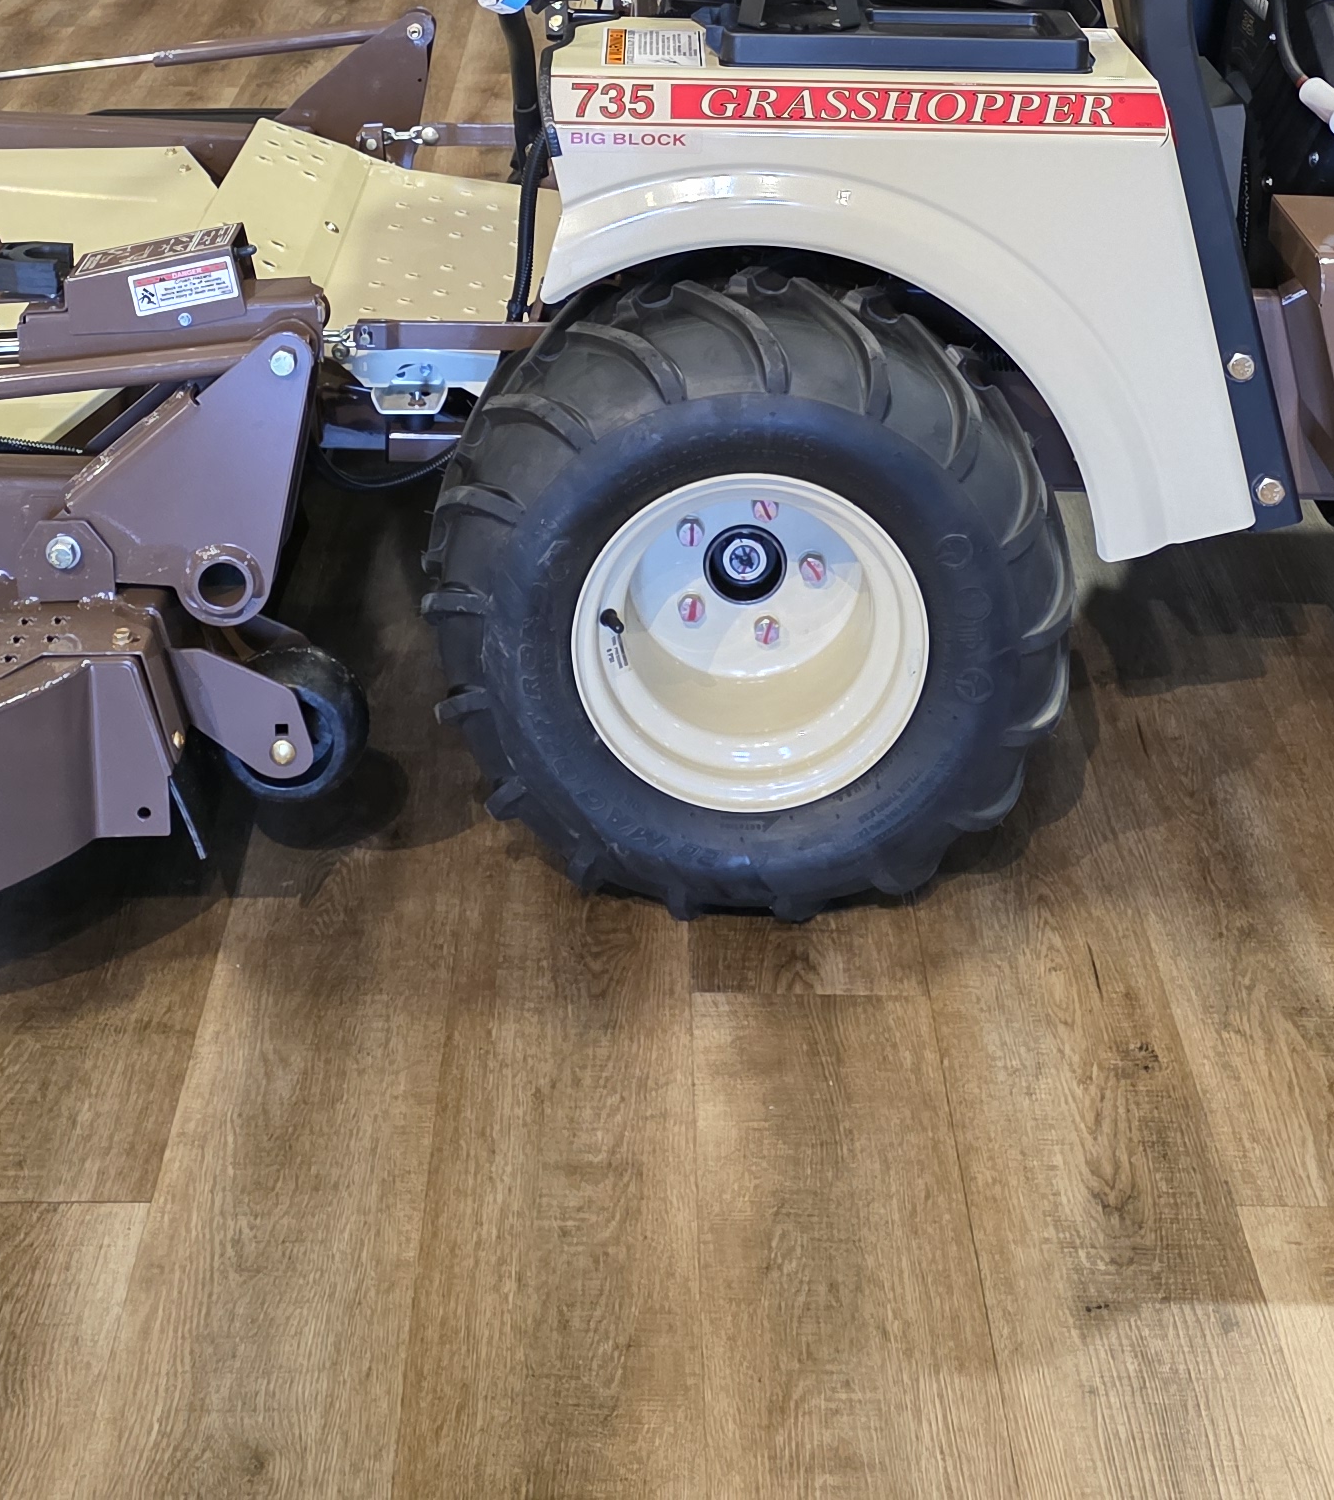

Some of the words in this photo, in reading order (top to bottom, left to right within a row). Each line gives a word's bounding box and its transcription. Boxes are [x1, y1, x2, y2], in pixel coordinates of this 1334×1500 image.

[571, 82, 656, 120] 735
[700, 87, 1114, 128] GRASSHOPPER
[569, 132, 607, 146] BIG
[612, 132, 687, 147] BLOCK
[171, 268, 202, 279] DANGER
